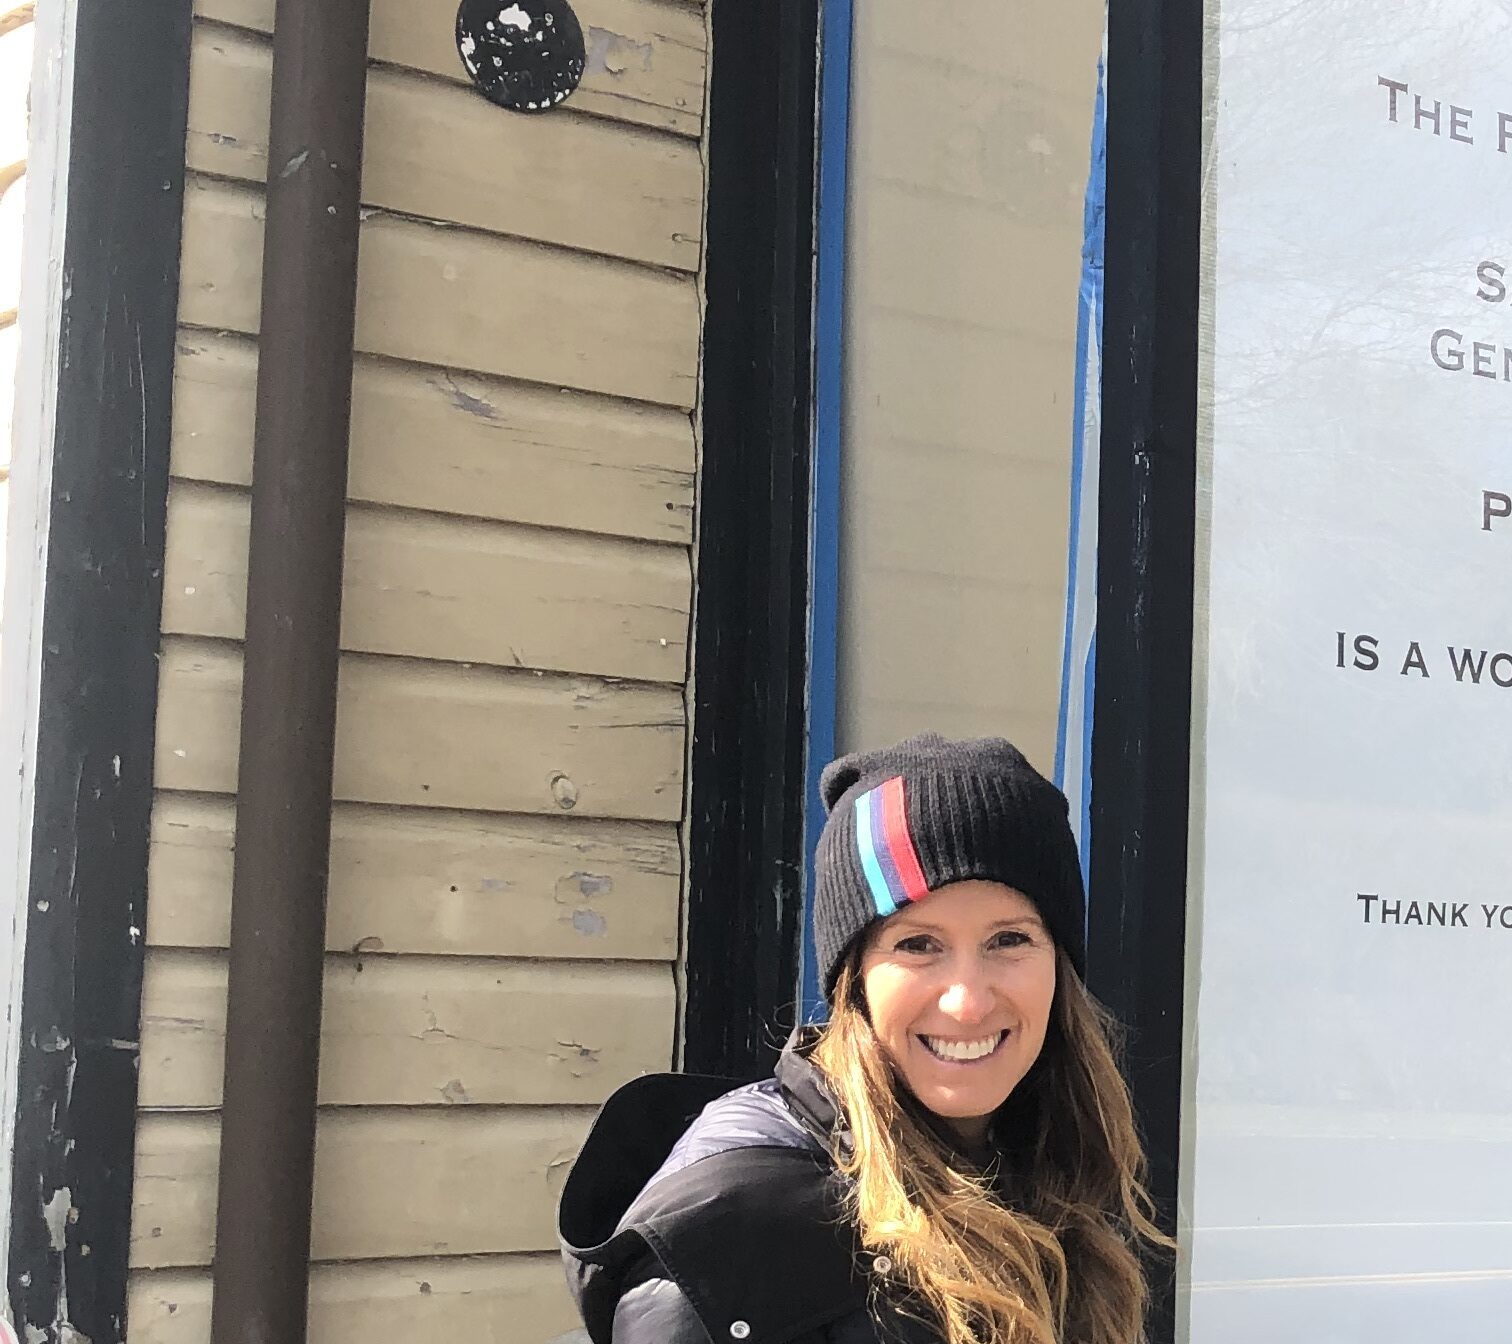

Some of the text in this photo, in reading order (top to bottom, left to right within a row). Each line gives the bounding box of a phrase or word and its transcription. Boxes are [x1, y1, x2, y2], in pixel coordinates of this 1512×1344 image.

[1378, 75, 1474, 146] THE
[1335, 631, 1380, 672] IS
[1400, 640, 1430, 678] A
[1356, 893, 1470, 929] THANK
